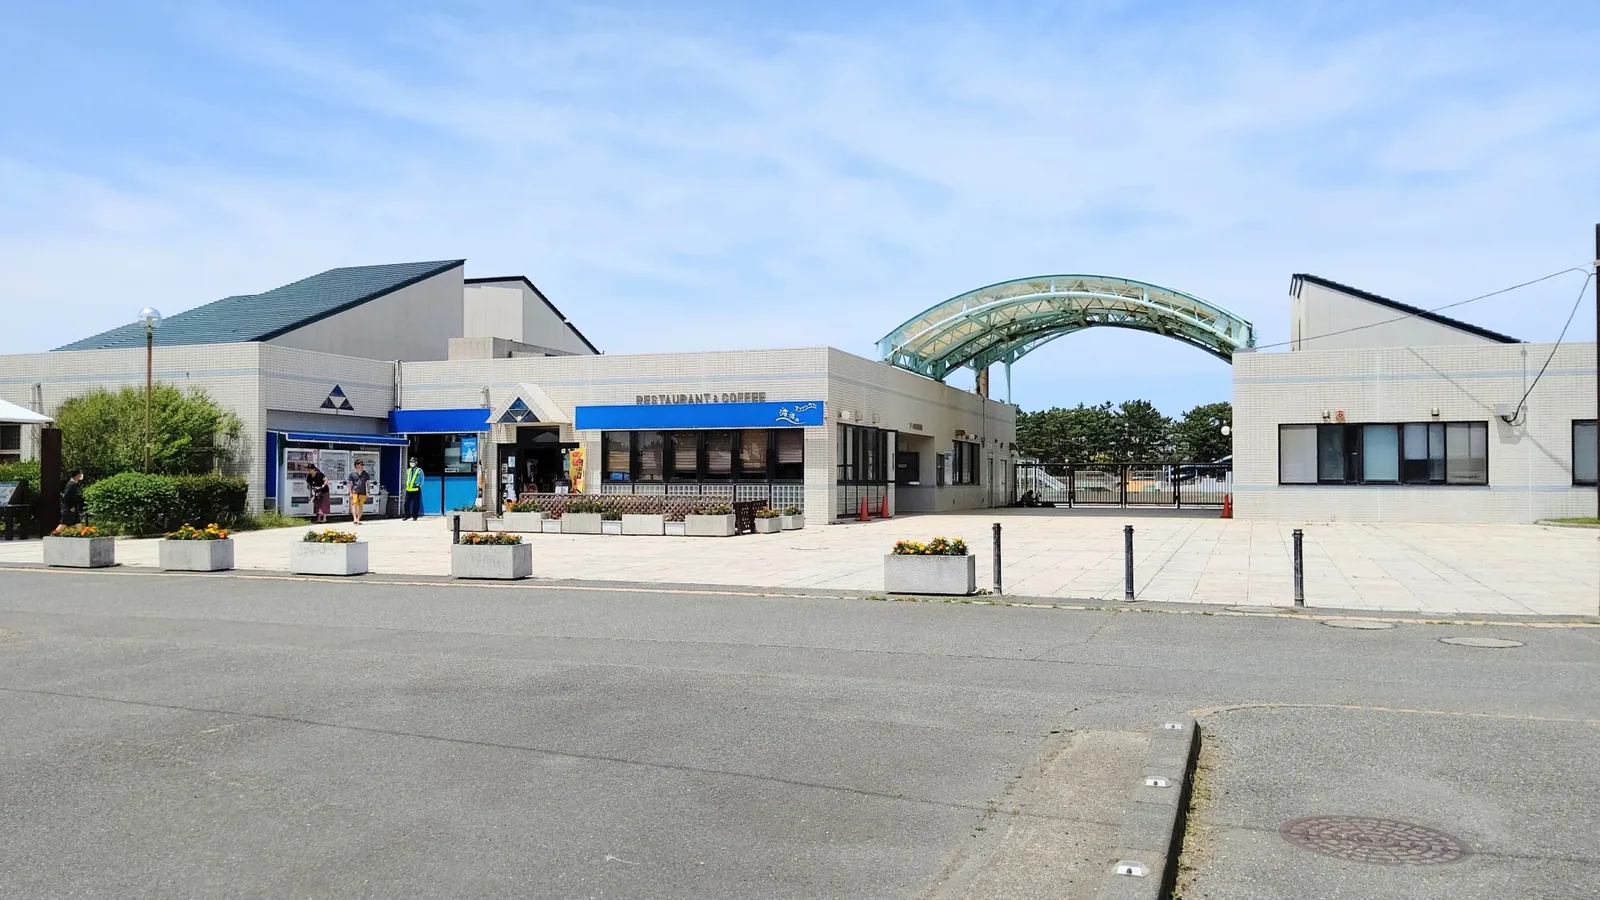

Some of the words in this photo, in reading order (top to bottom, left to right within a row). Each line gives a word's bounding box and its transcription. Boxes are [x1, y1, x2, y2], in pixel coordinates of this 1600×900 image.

[636, 393, 711, 405] RESTAURANT
[713, 394, 719, 403] &
[722, 392, 766, 403] COFFEE
